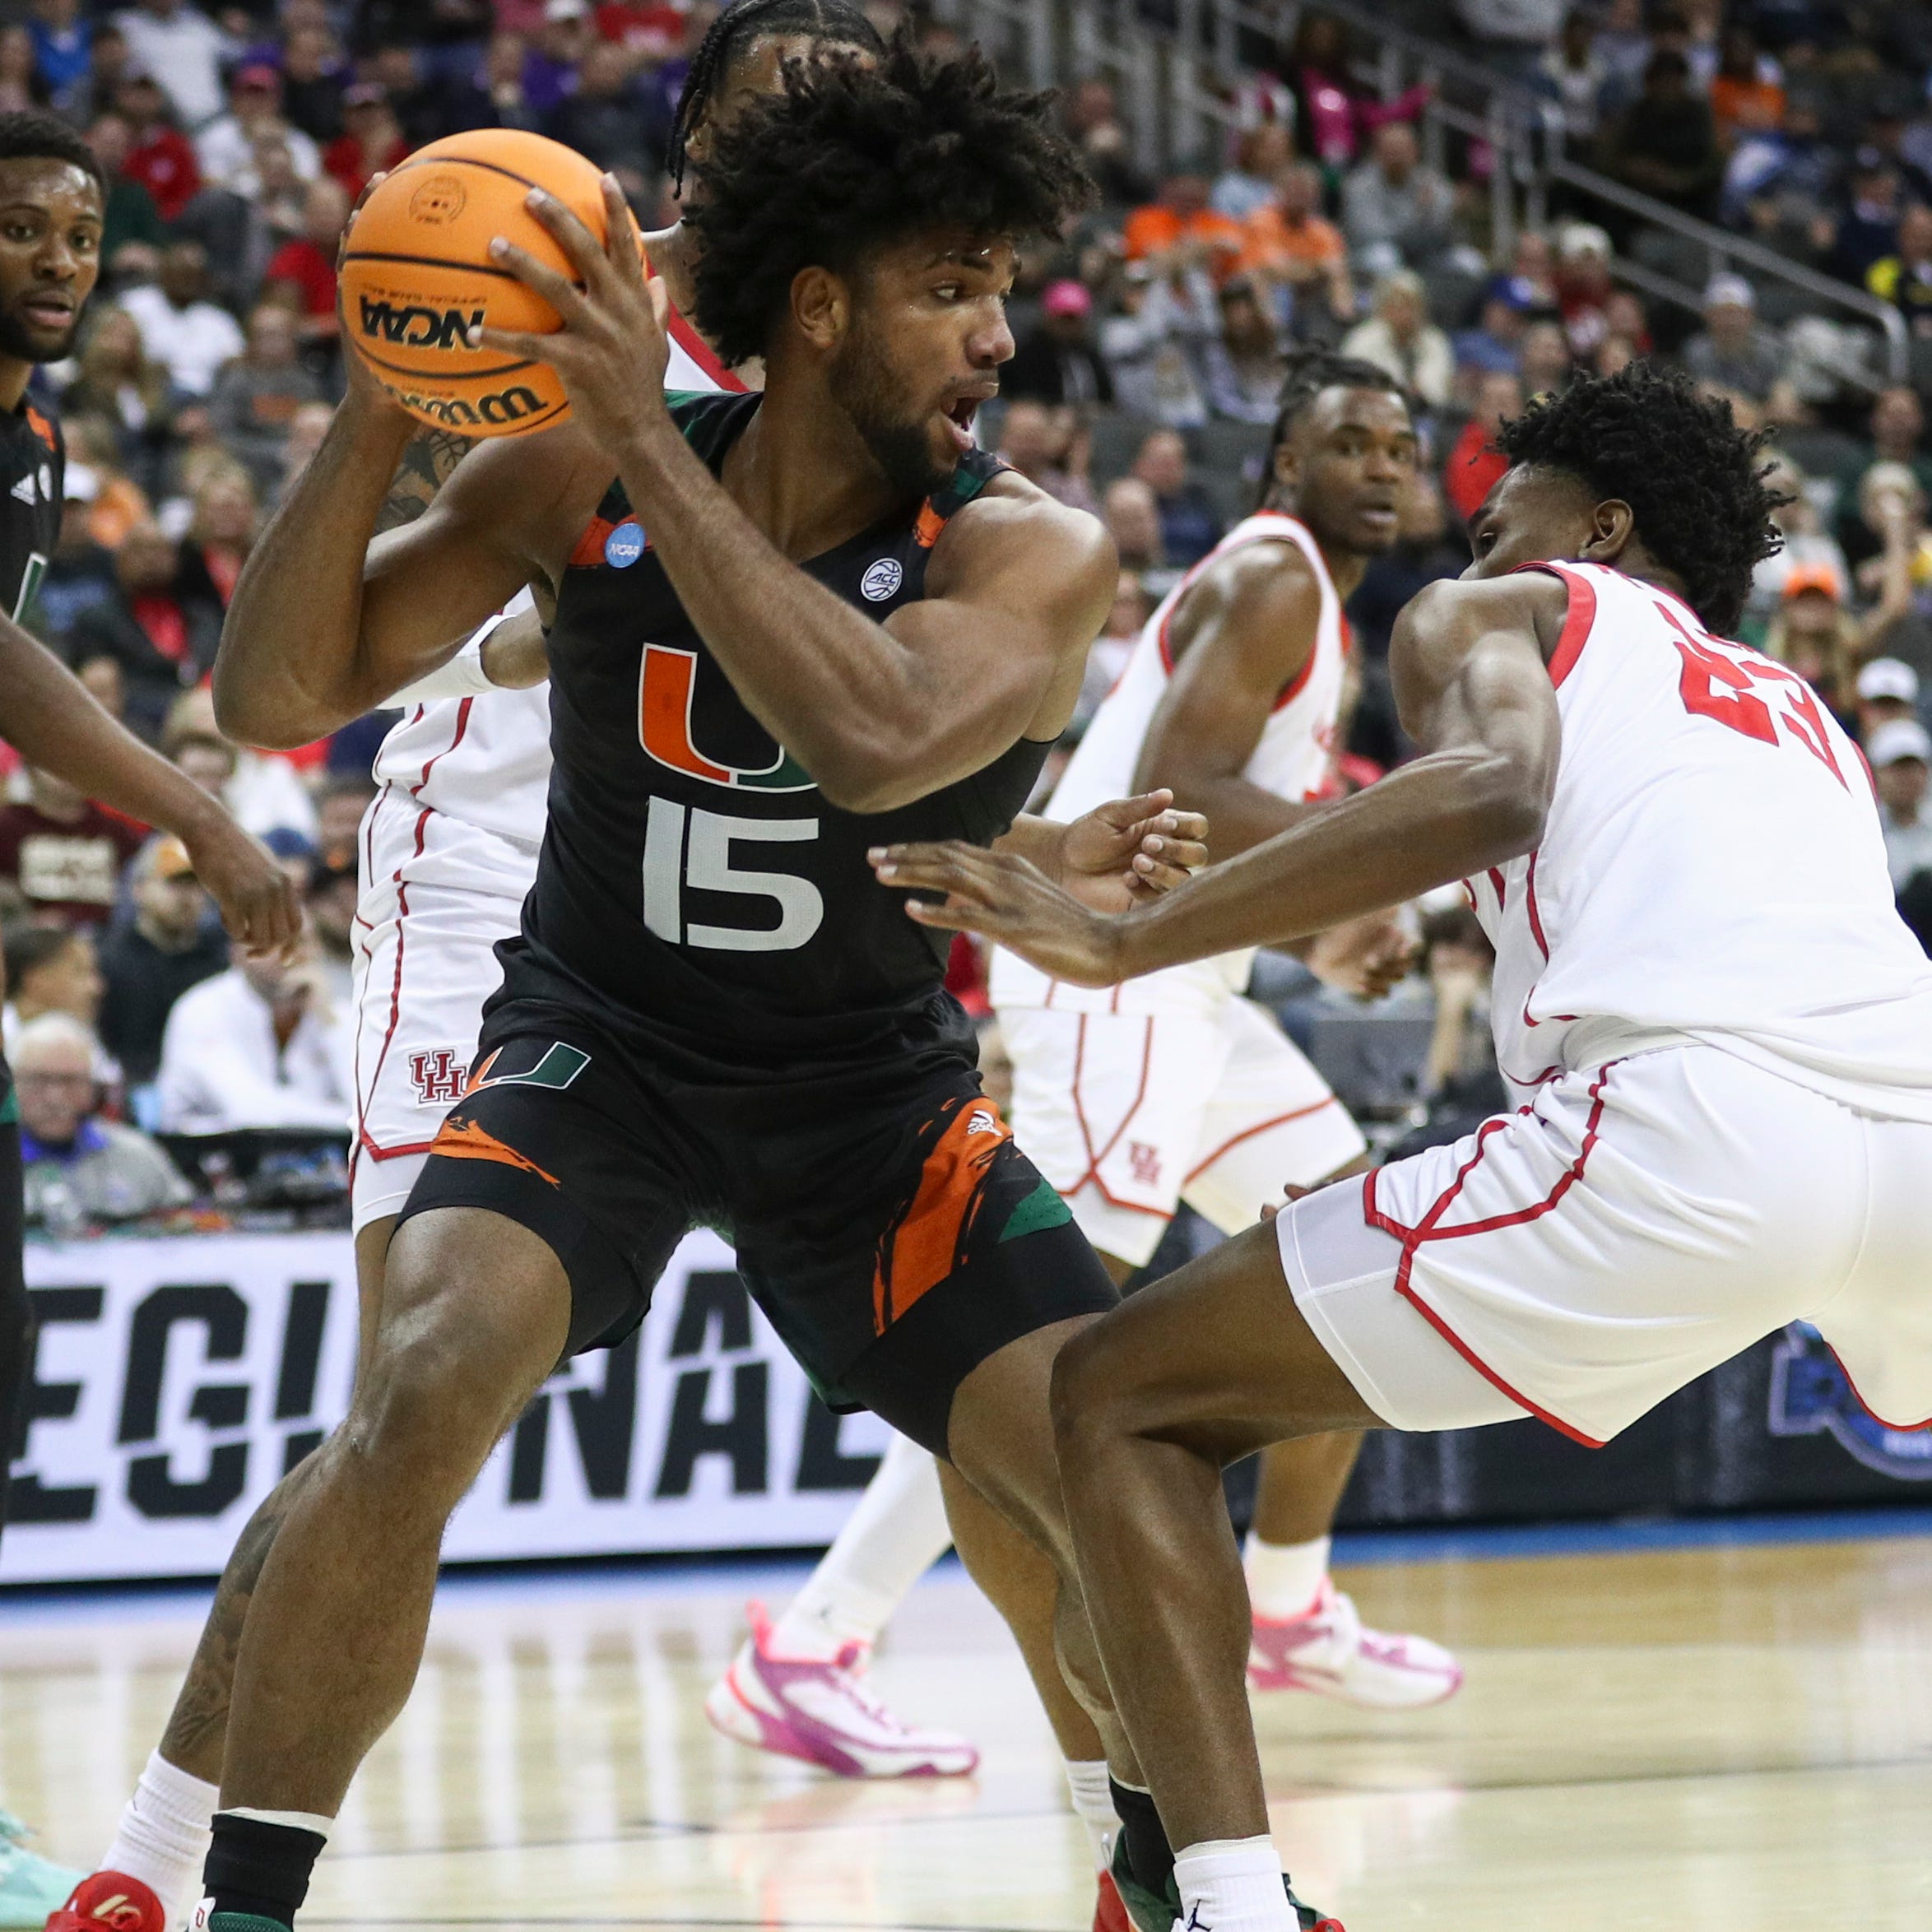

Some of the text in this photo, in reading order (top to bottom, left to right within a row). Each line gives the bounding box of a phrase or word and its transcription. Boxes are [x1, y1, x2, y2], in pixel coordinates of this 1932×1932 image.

[360, 295, 485, 352] NCAA
[382, 384, 549, 425] Wil
[610, 543, 640, 557] NCAA
[867, 572, 900, 584] ACC
[642, 794, 824, 952] 15
[409, 1049, 469, 1104] UH
